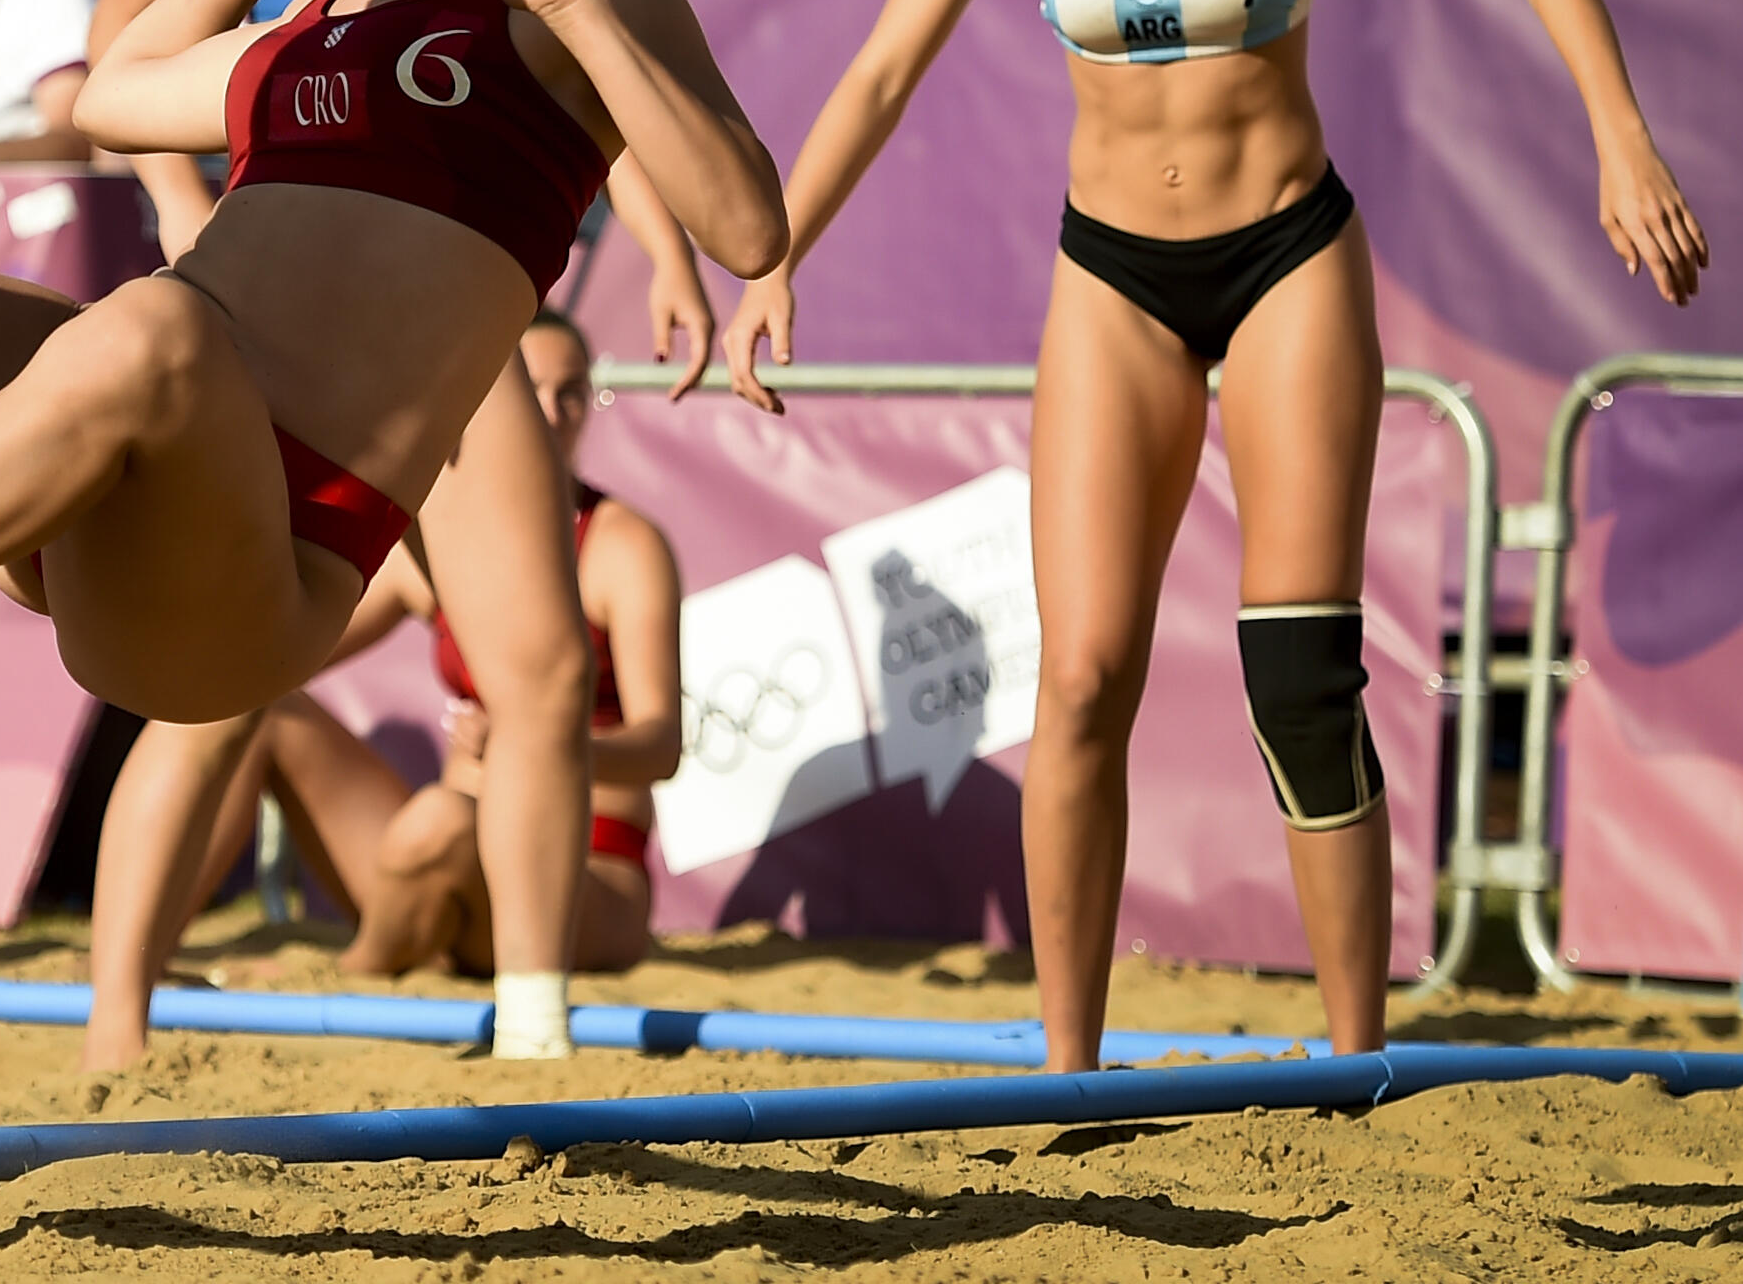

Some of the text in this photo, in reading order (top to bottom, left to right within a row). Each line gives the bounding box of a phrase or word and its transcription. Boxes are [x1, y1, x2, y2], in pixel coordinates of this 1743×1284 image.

[1122, 14, 1184, 44] ARG
[395, 28, 472, 107] 6
[293, 70, 351, 127] CRO
